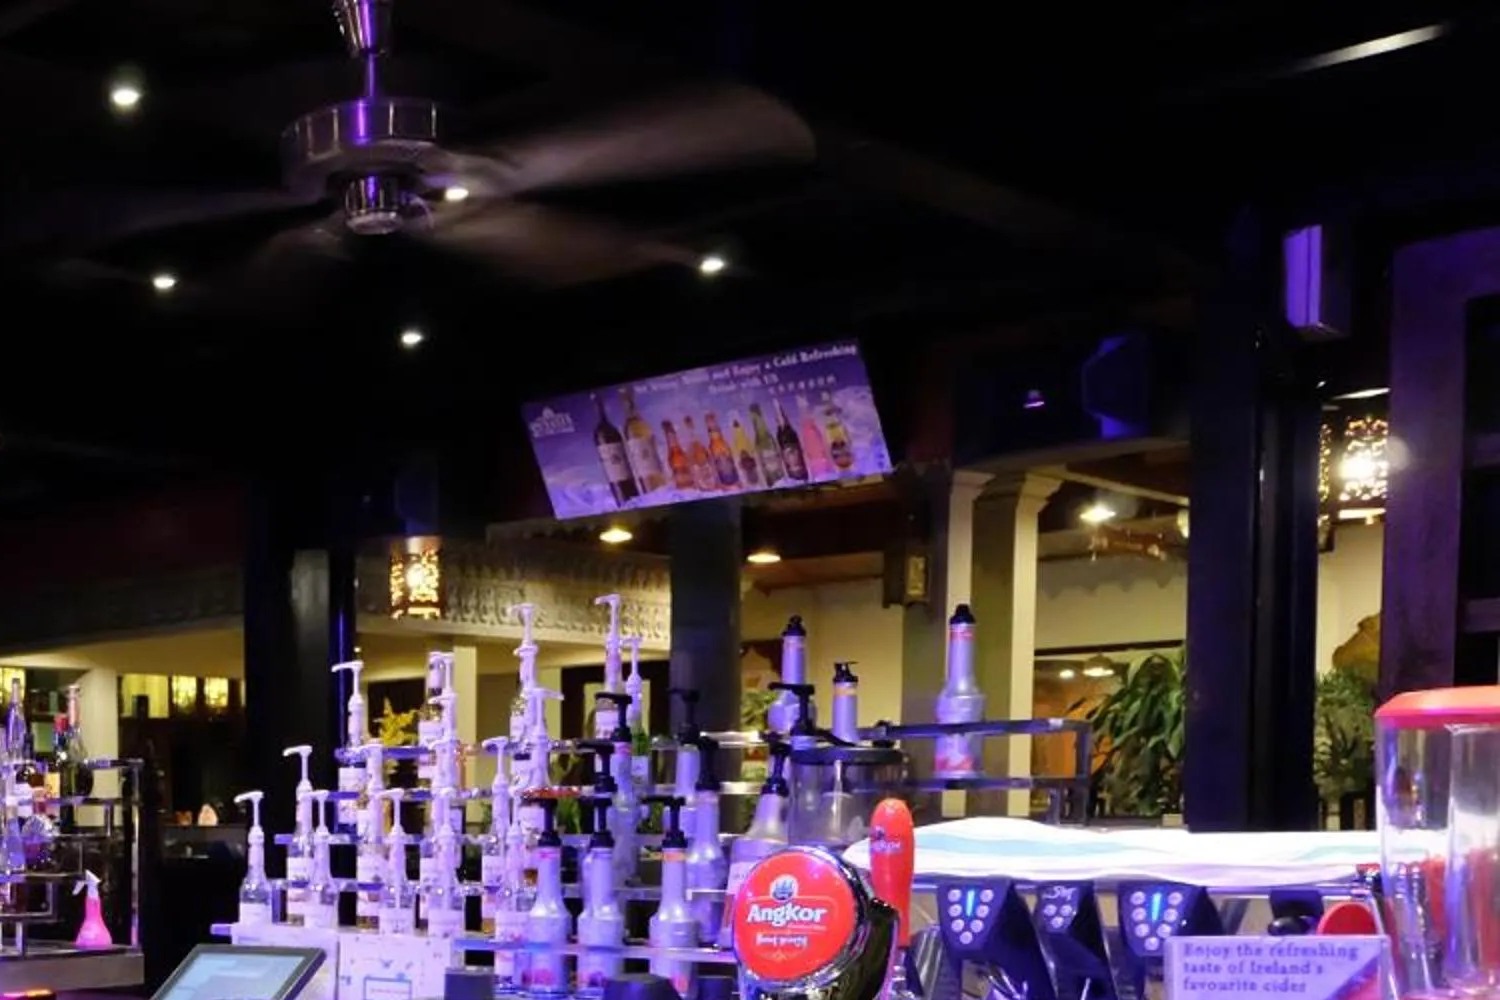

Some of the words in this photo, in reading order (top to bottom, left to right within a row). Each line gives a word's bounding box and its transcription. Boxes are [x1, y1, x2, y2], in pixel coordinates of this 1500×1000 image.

[746, 902, 828, 927] Angkor
[1183, 943, 1232, 960] Enjoy
[1237, 943, 1262, 957] the
[1269, 943, 1360, 960] refreshing
[1183, 961, 1222, 974] taste
[1228, 961, 1245, 974] of
[1183, 978, 1257, 992] favourite
[1263, 978, 1307, 993] cider
